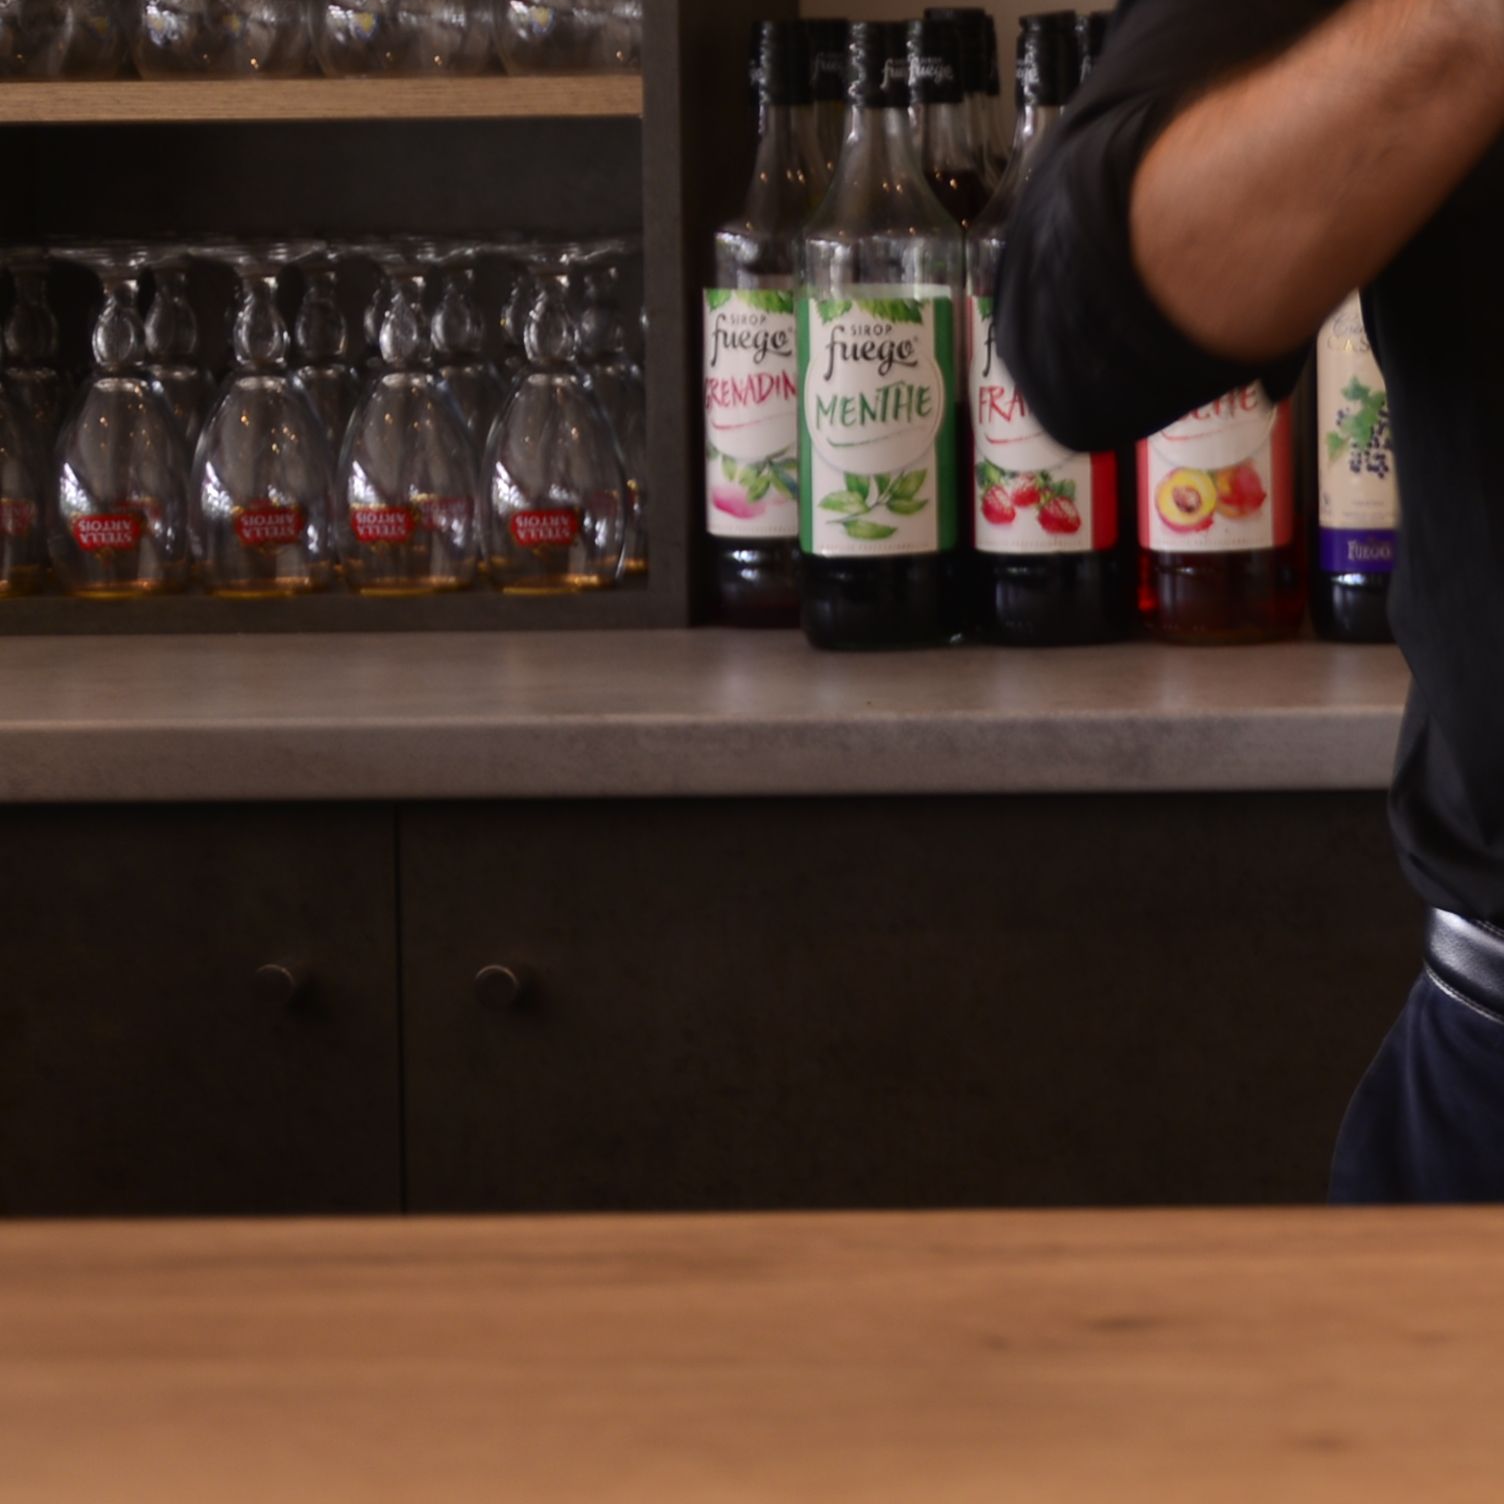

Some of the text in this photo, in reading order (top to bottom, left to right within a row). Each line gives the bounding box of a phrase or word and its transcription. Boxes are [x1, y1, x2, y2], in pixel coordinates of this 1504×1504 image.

[711, 313, 793, 368] fuego
[730, 313, 767, 325] SIROP
[850, 324, 893, 337] SIROP
[824, 324, 919, 382] fuego
[816, 380, 933, 431] MENTHE
[979, 385, 1026, 425] FRA
